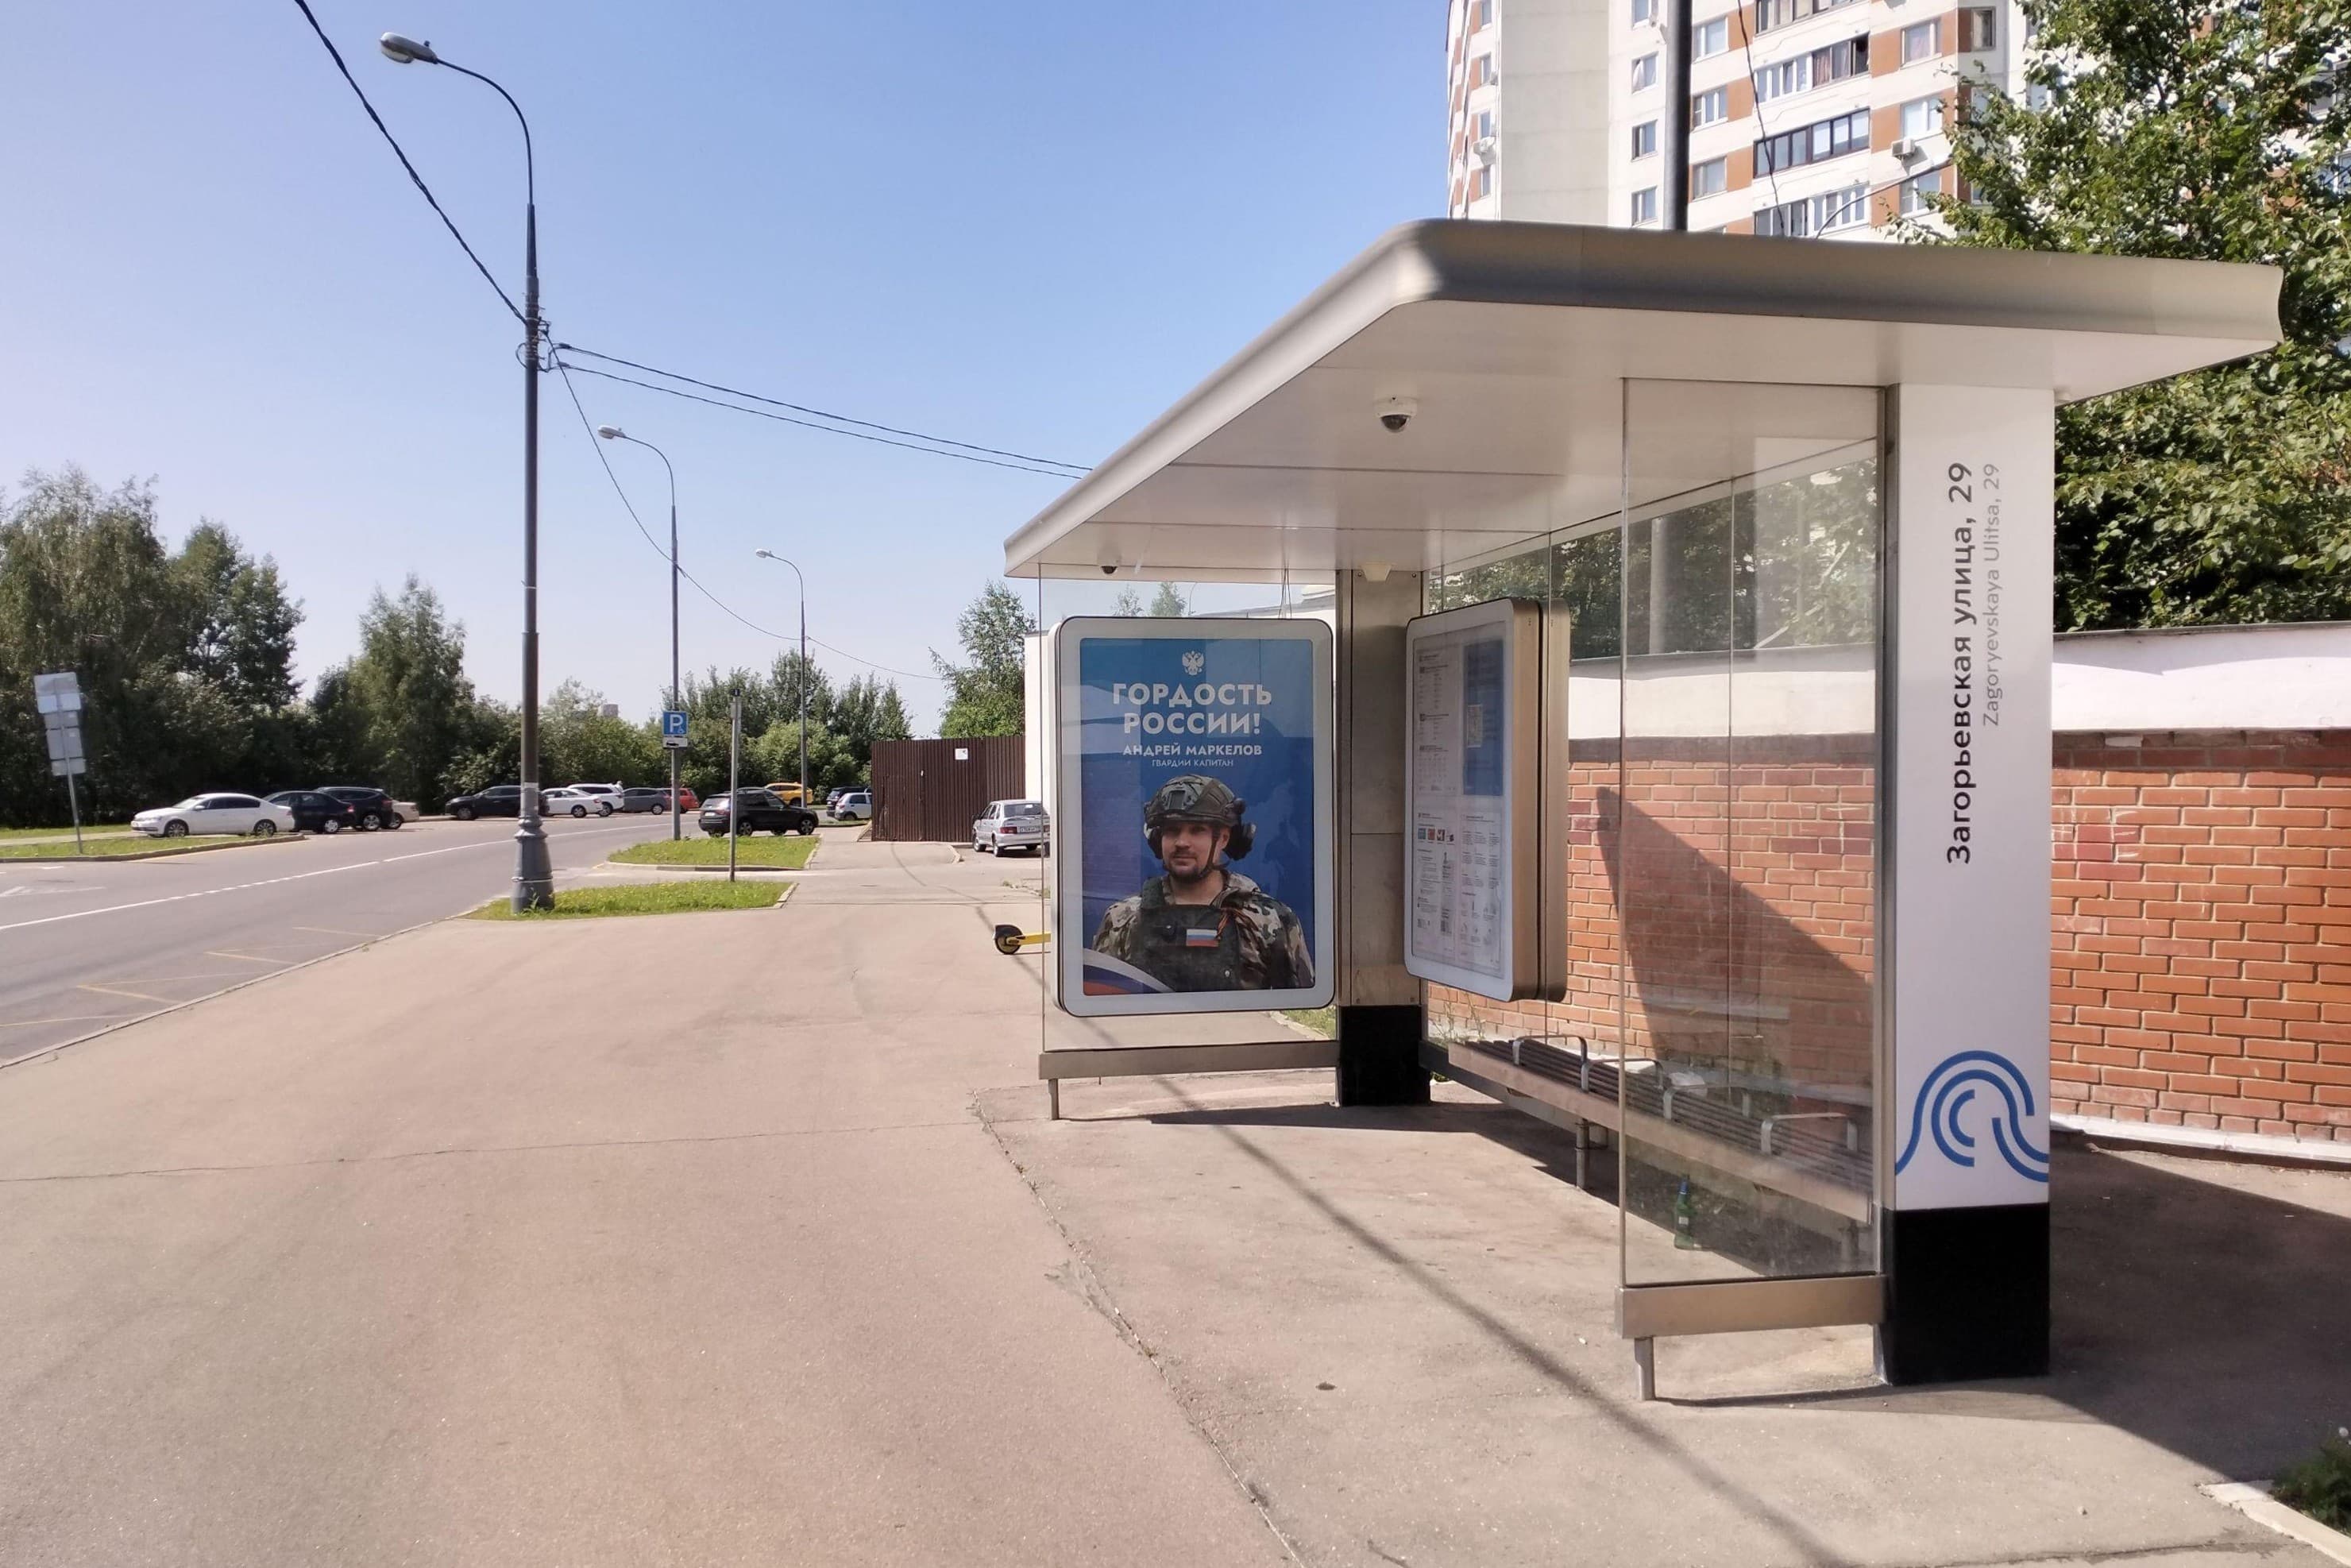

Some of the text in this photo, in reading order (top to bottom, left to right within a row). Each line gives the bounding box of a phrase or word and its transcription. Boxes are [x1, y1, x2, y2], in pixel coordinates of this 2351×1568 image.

[1982, 463, 2002, 726] Zagoryevskaya Ulitsa, 29
[1947, 462, 1977, 864] Загорьевская улица, 29
[1113, 683, 1272, 708] ГОРДОСТЬ
[1124, 713, 1260, 734] РОССИИ!
[1122, 742, 1262, 756] АНДРЕЙ МАРКЕЛОВ
